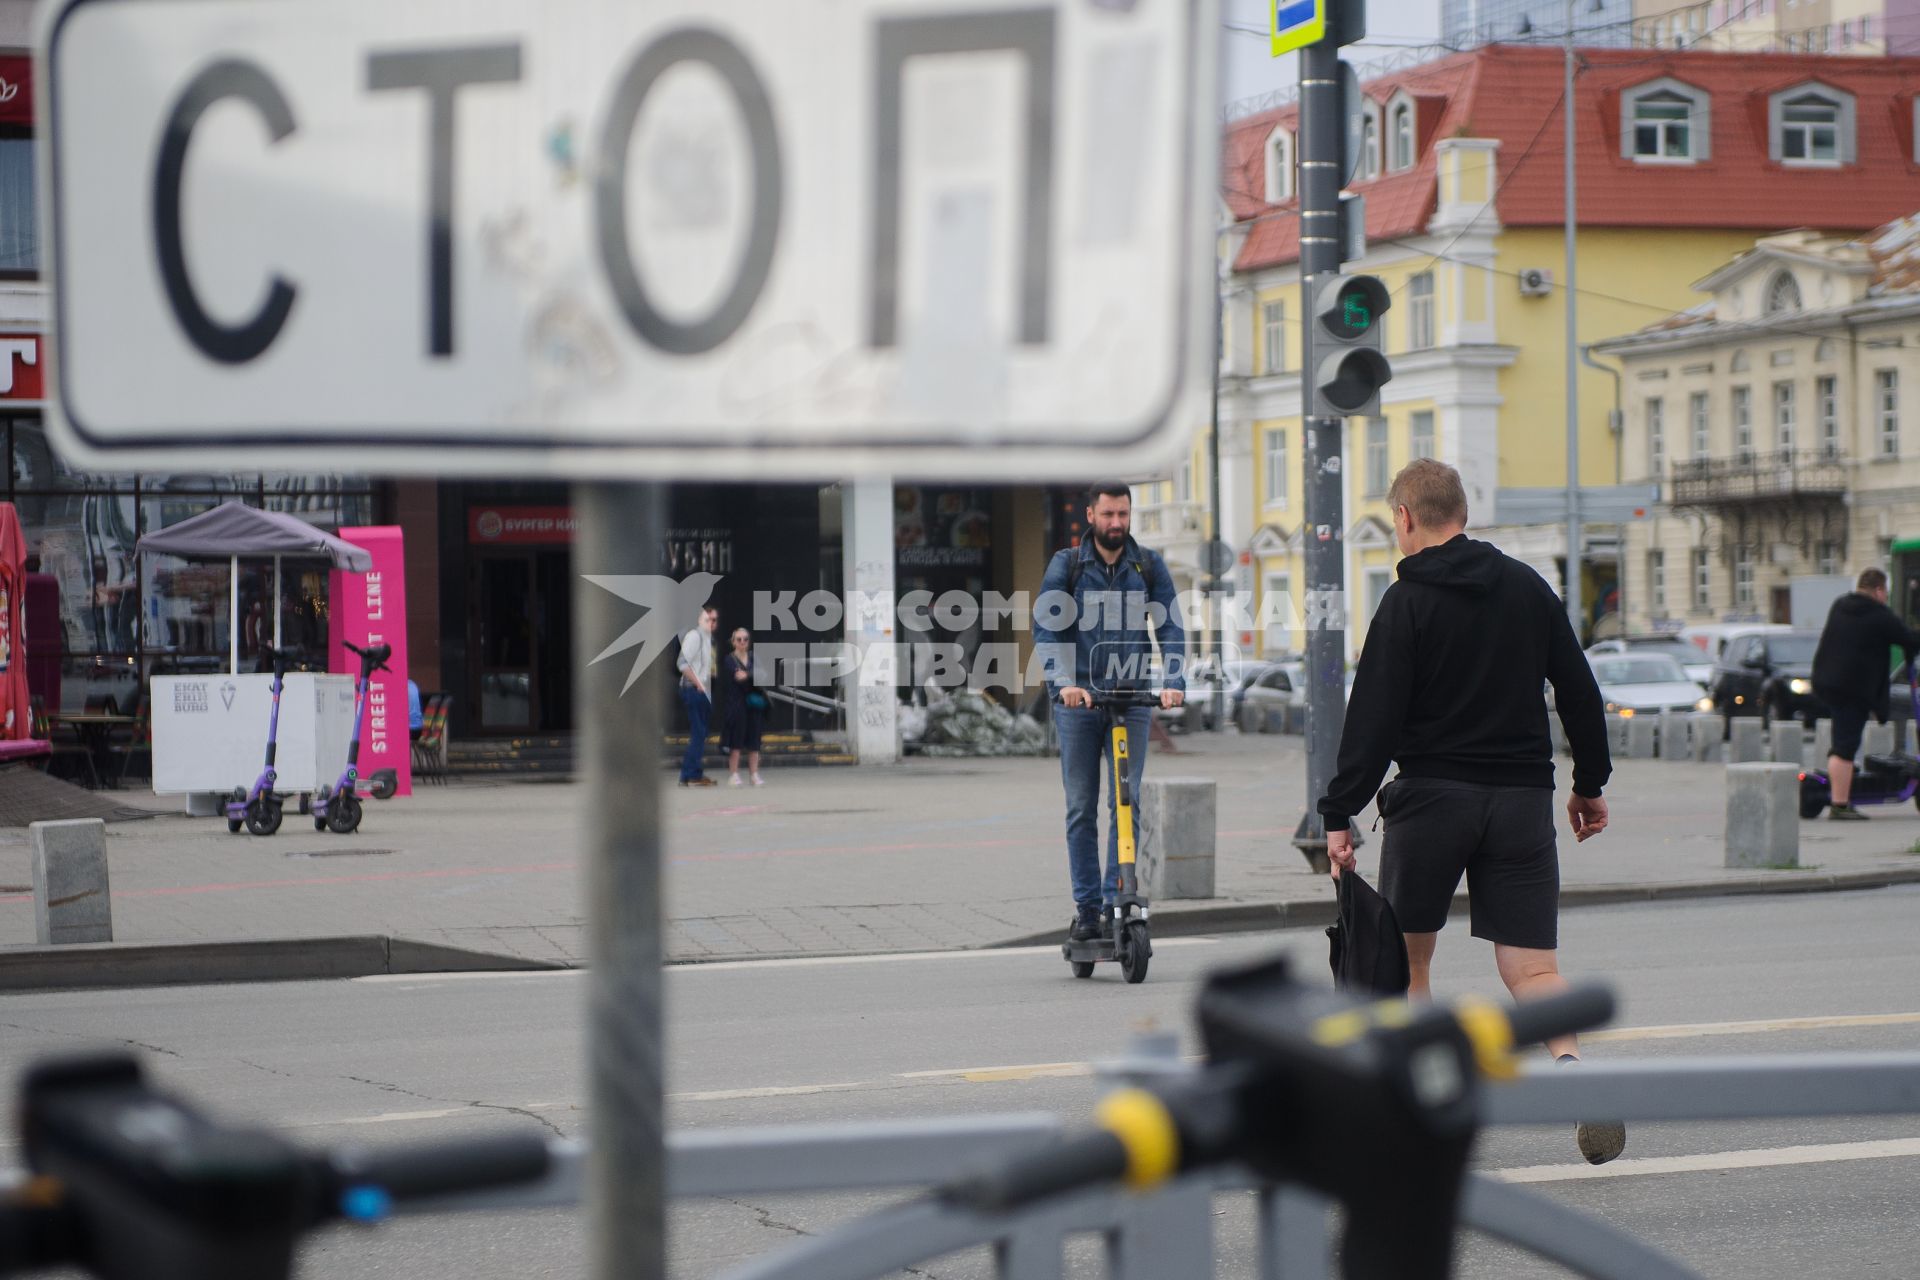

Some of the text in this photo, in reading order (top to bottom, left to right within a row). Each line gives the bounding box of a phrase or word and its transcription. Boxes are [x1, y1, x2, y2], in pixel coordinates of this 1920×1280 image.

[152, 12, 1057, 362] СТОП
[504, 518, 553, 531] БУРГЕР
[556, 518, 583, 531] КИН
[367, 571, 382, 620] LINE
[371, 682, 387, 753] STREET
